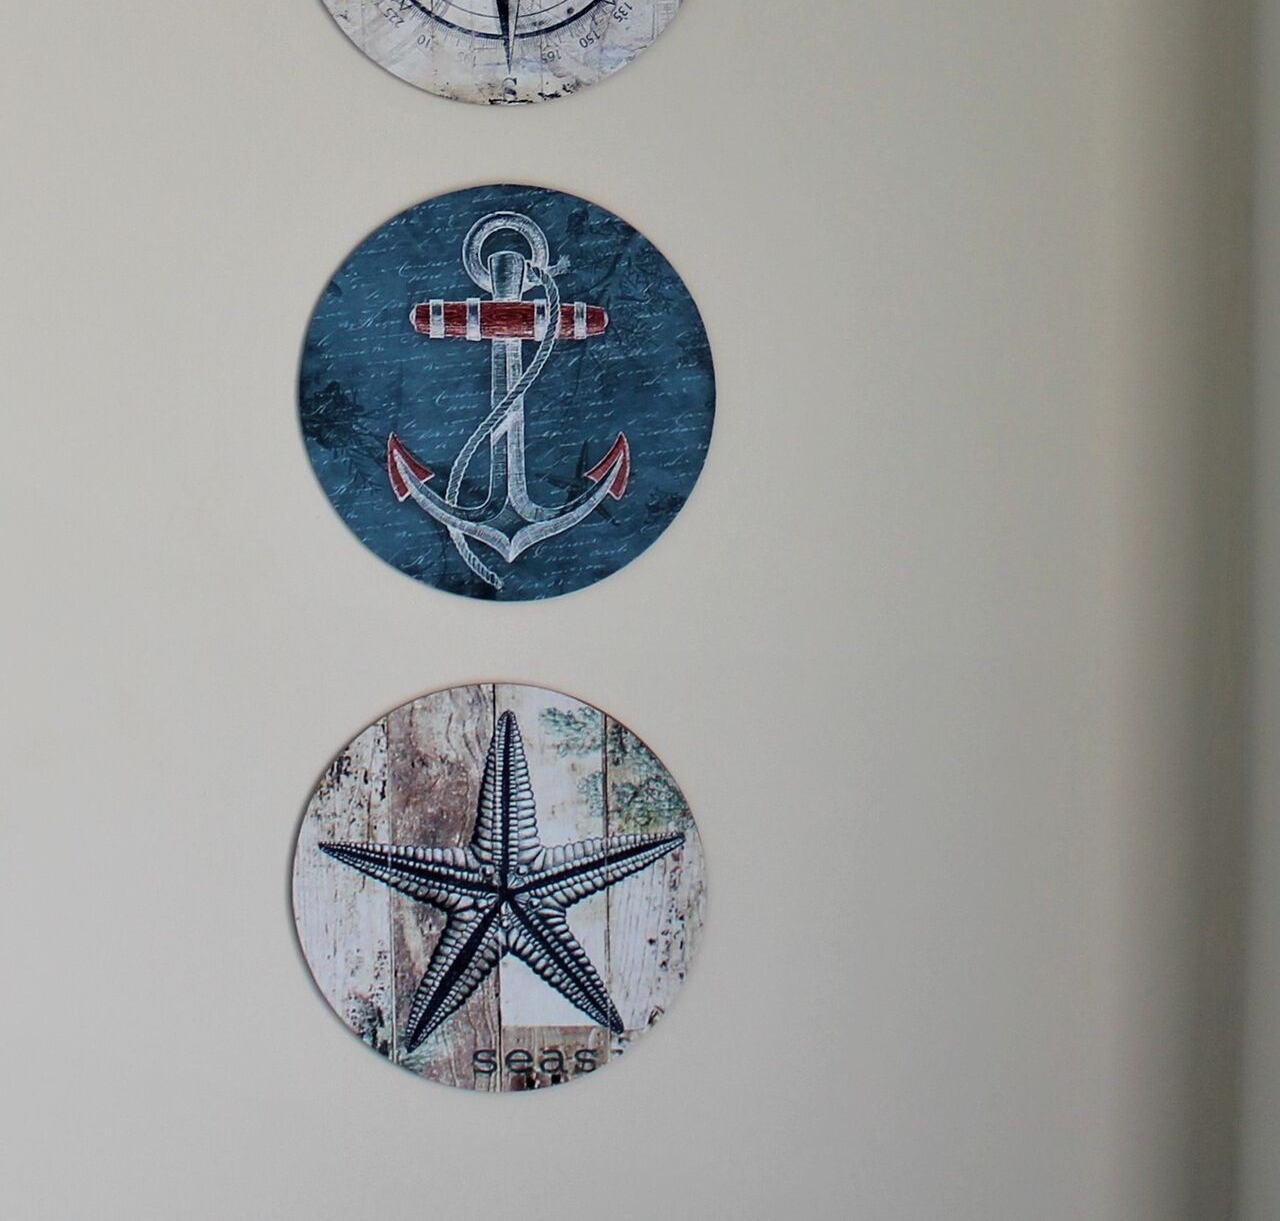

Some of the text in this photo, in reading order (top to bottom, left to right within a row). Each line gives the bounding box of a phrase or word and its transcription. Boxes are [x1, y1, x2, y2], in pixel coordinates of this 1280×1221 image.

[383, 7, 406, 29] 225
[612, 1, 634, 24] 135
[578, 30, 602, 49] 150
[541, 50, 562, 65] 165
